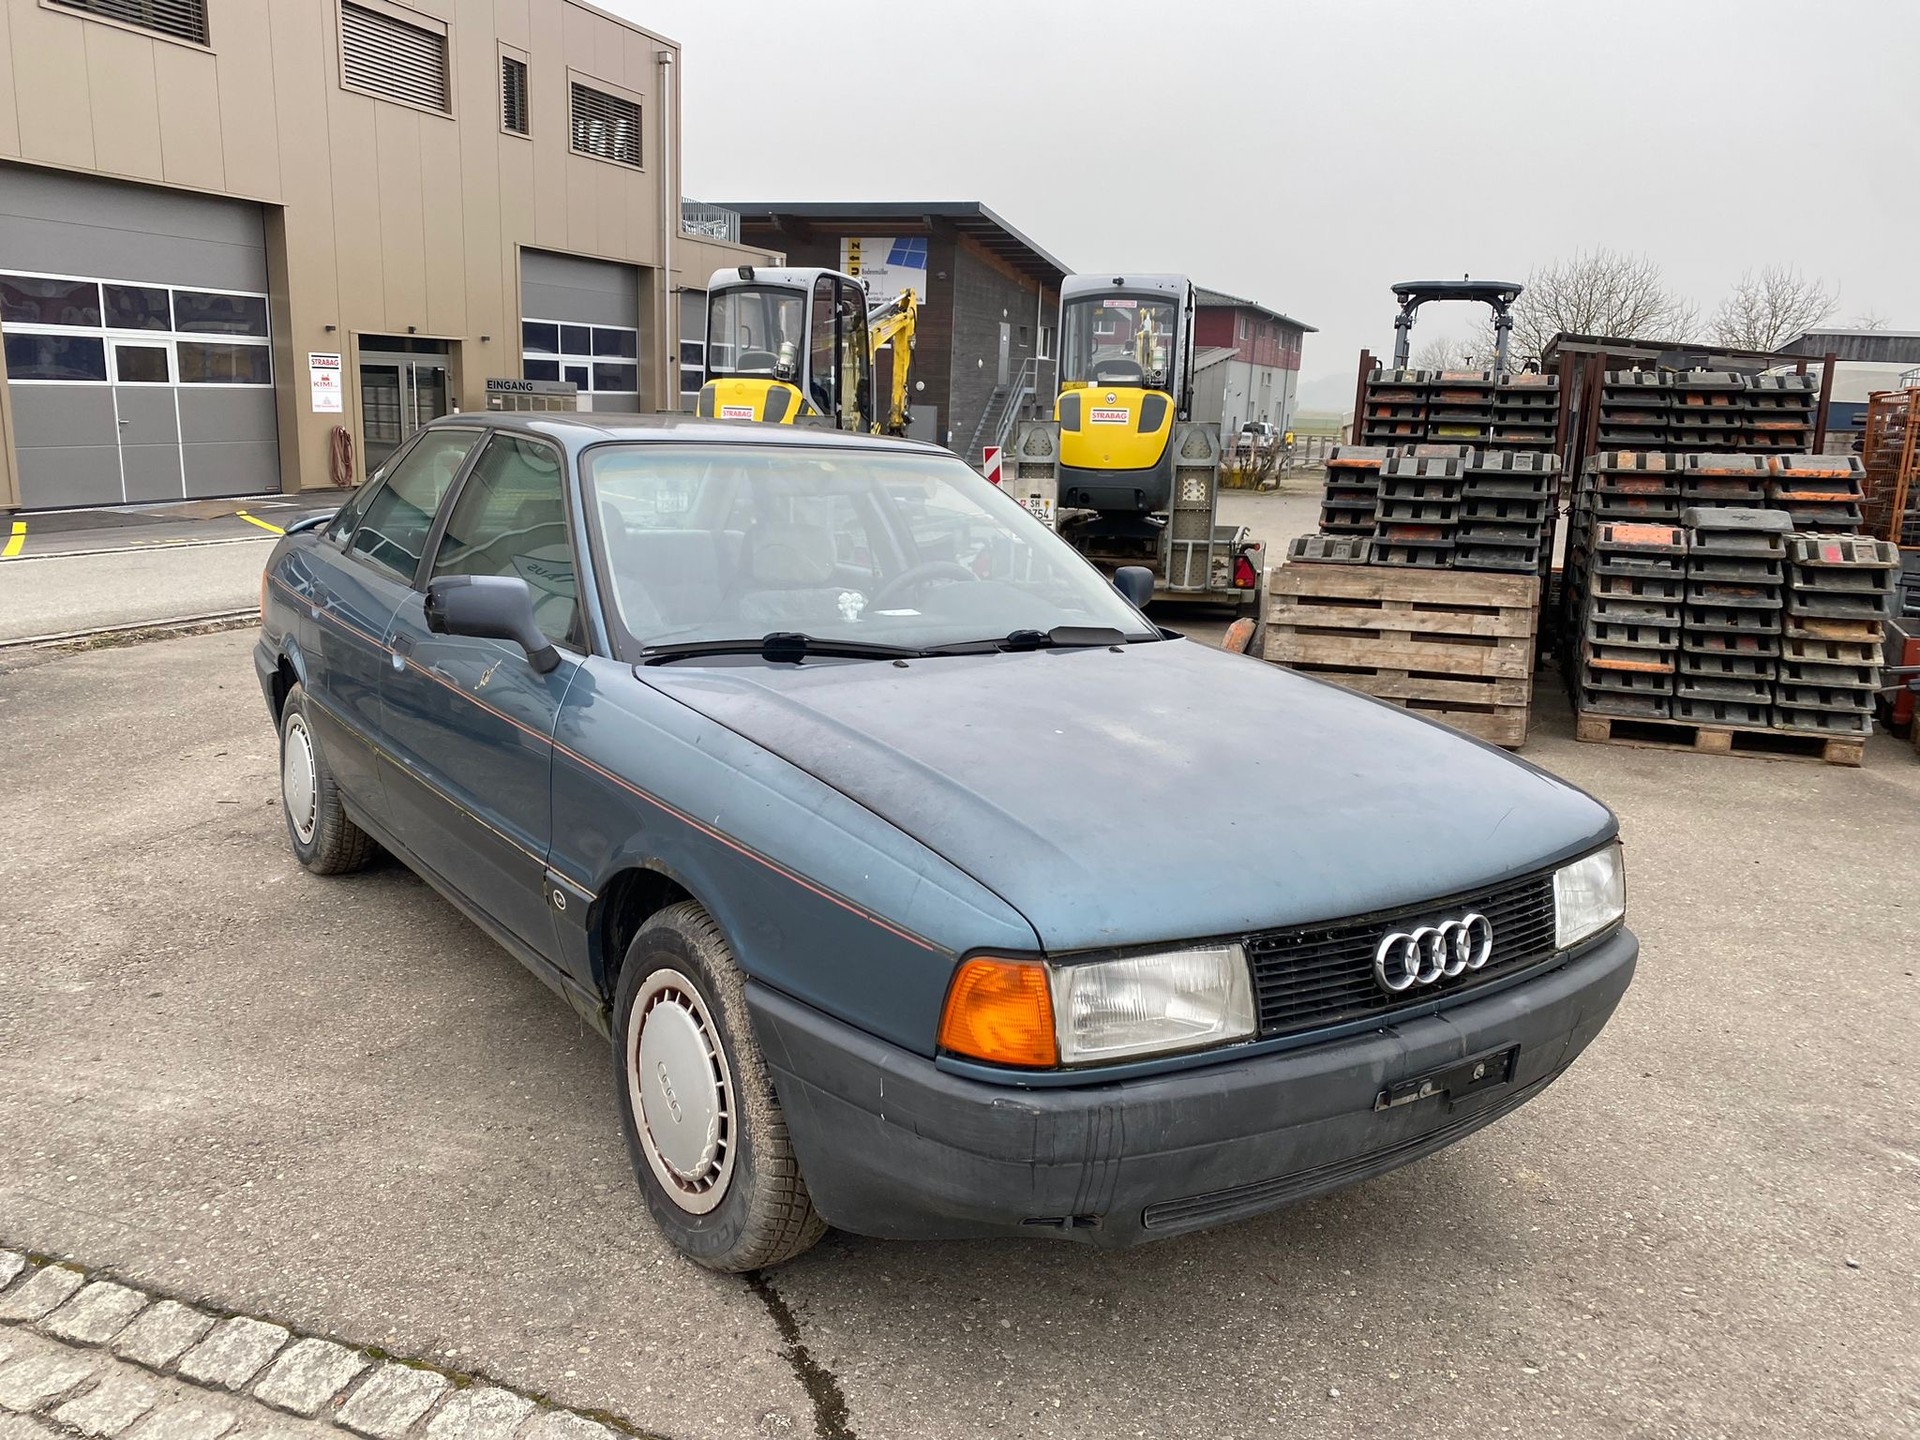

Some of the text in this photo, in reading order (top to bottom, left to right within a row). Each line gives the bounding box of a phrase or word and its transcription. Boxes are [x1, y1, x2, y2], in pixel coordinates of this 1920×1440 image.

[849, 242, 861, 276] utz
[311, 358, 339, 366] STRABAG
[487, 380, 533, 391] EINGANG
[1028, 508, 1049, 519] 754
